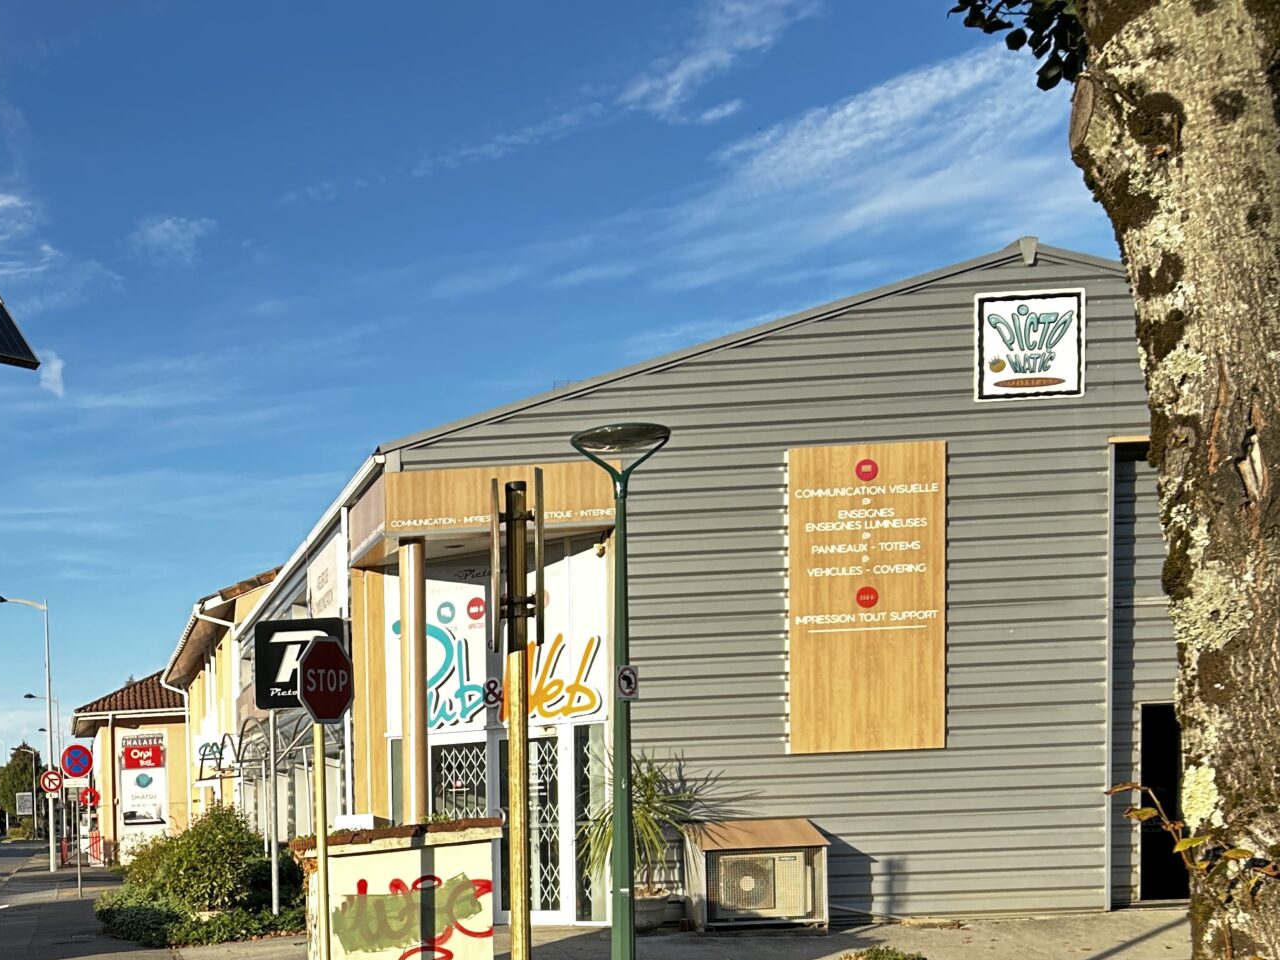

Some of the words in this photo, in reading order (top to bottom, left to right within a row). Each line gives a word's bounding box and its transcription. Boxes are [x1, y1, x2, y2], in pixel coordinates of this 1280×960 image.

[987, 304, 1074, 352] PICTO
[794, 486, 886, 499] COMMUNICATION
[889, 483, 939, 494] VISUELLE
[838, 508, 895, 519] ENSEIGNES
[391, 517, 456, 528] COMMUNICATION
[463, 515, 492, 524] IMPRES
[805, 521, 862, 532] ENSEIGNES
[864, 518, 928, 530] LUMINEUSES
[812, 543, 868, 554] PANNEAUX
[879, 541, 921, 551] TOTEMS
[807, 566, 863, 577] VEHICULES
[873, 563, 927, 574] COVERING
[795, 614, 856, 625] IMPRESSION
[858, 612, 887, 622] TOUT
[890, 610, 939, 620] SUPPORT
[306, 668, 348, 692] STOP
[270, 688, 298, 697] Picto
[131, 748, 152, 760] Orpi
